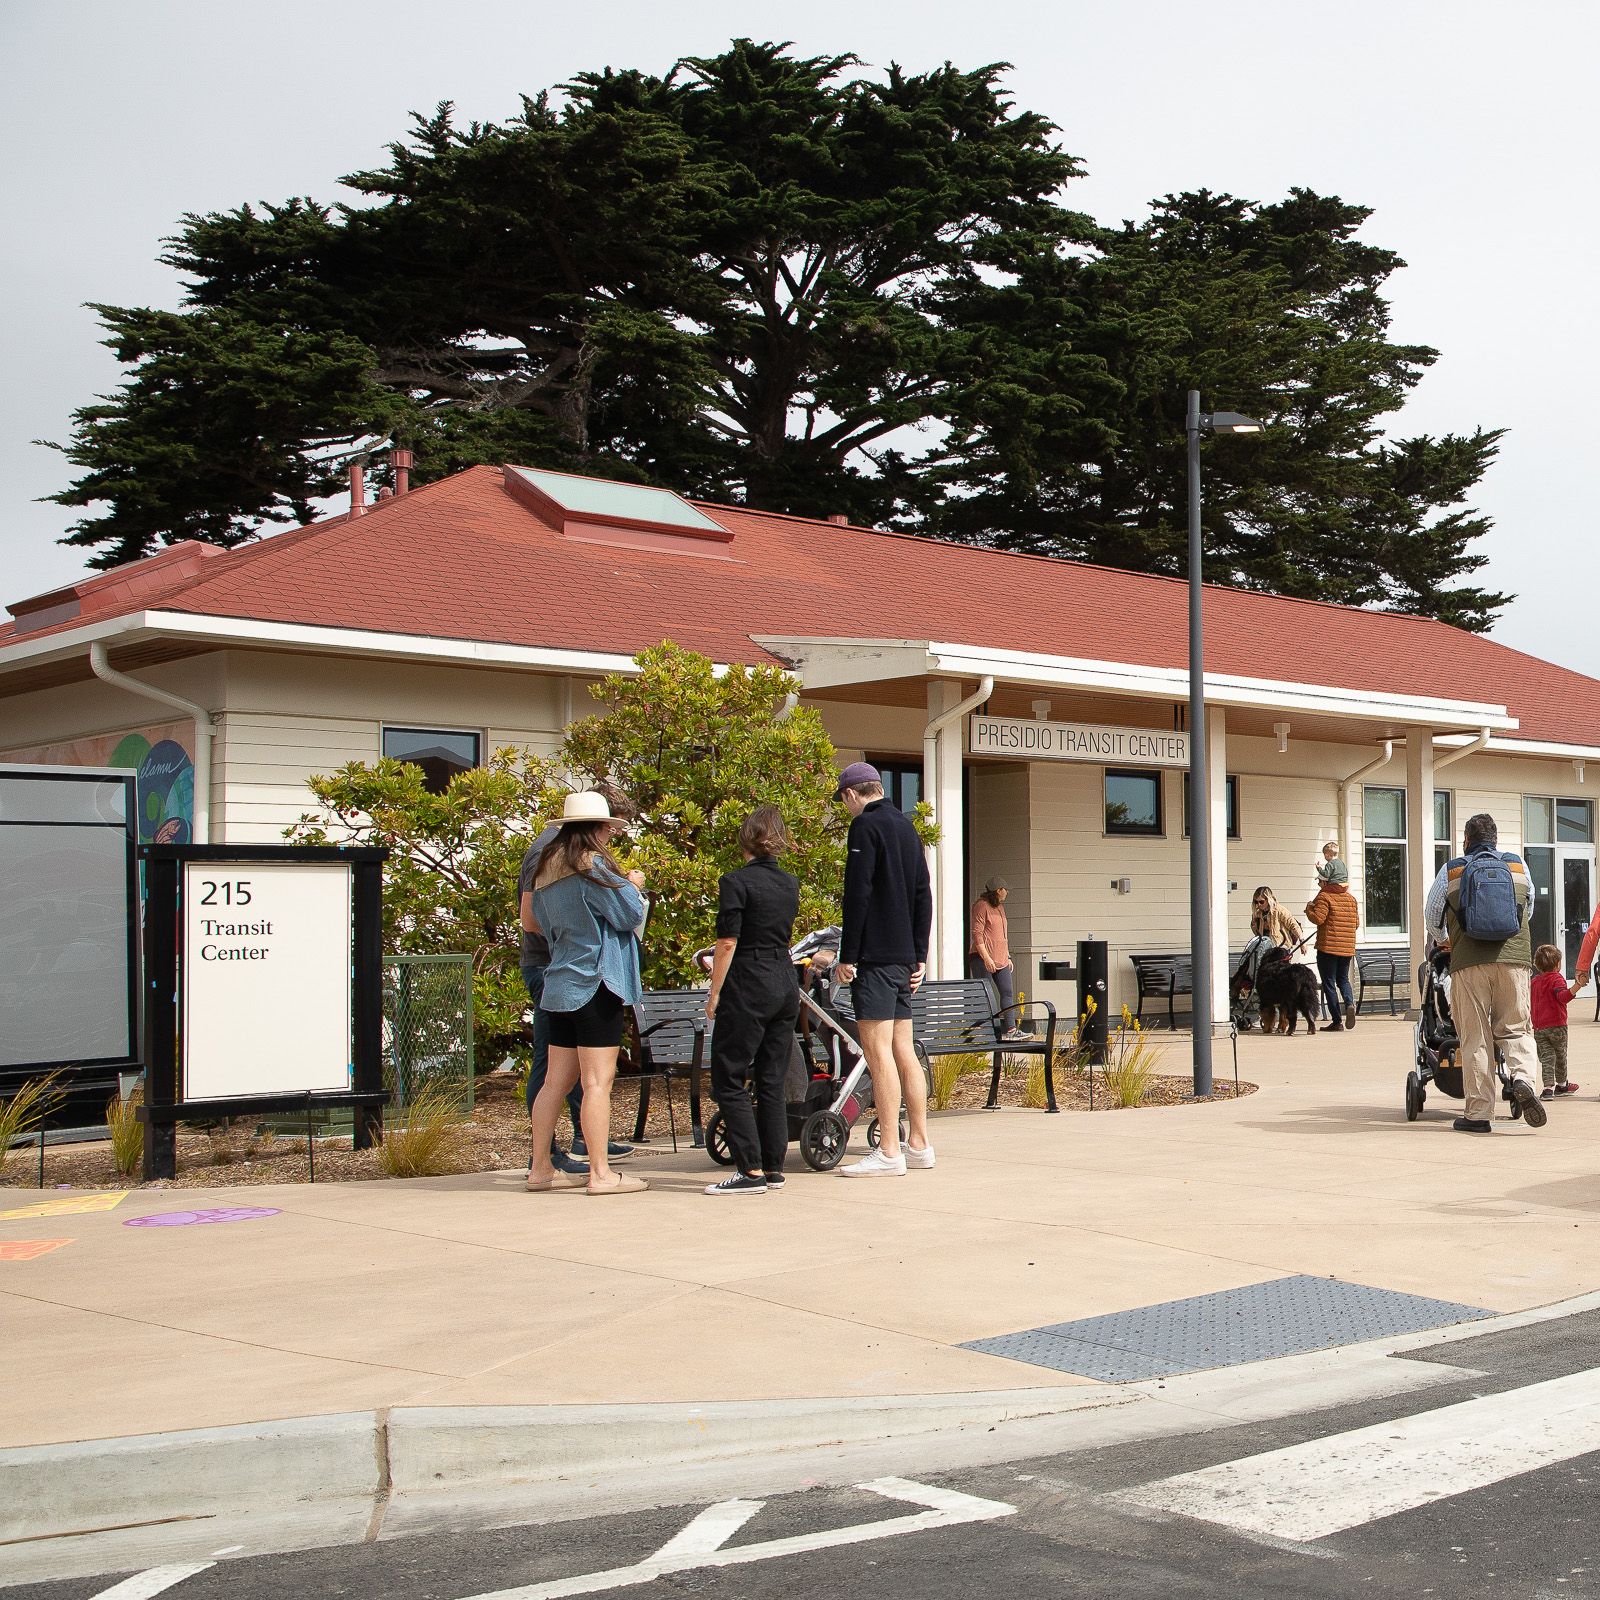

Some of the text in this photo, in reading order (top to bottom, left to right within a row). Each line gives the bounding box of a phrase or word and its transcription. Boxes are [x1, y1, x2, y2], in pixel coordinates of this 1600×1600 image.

[978, 723, 1186, 759] PRESIDIO TRANSIT CENTER
[200, 881, 252, 906] 215
[200, 919, 274, 936] Transit
[200, 944, 270, 961] Center
